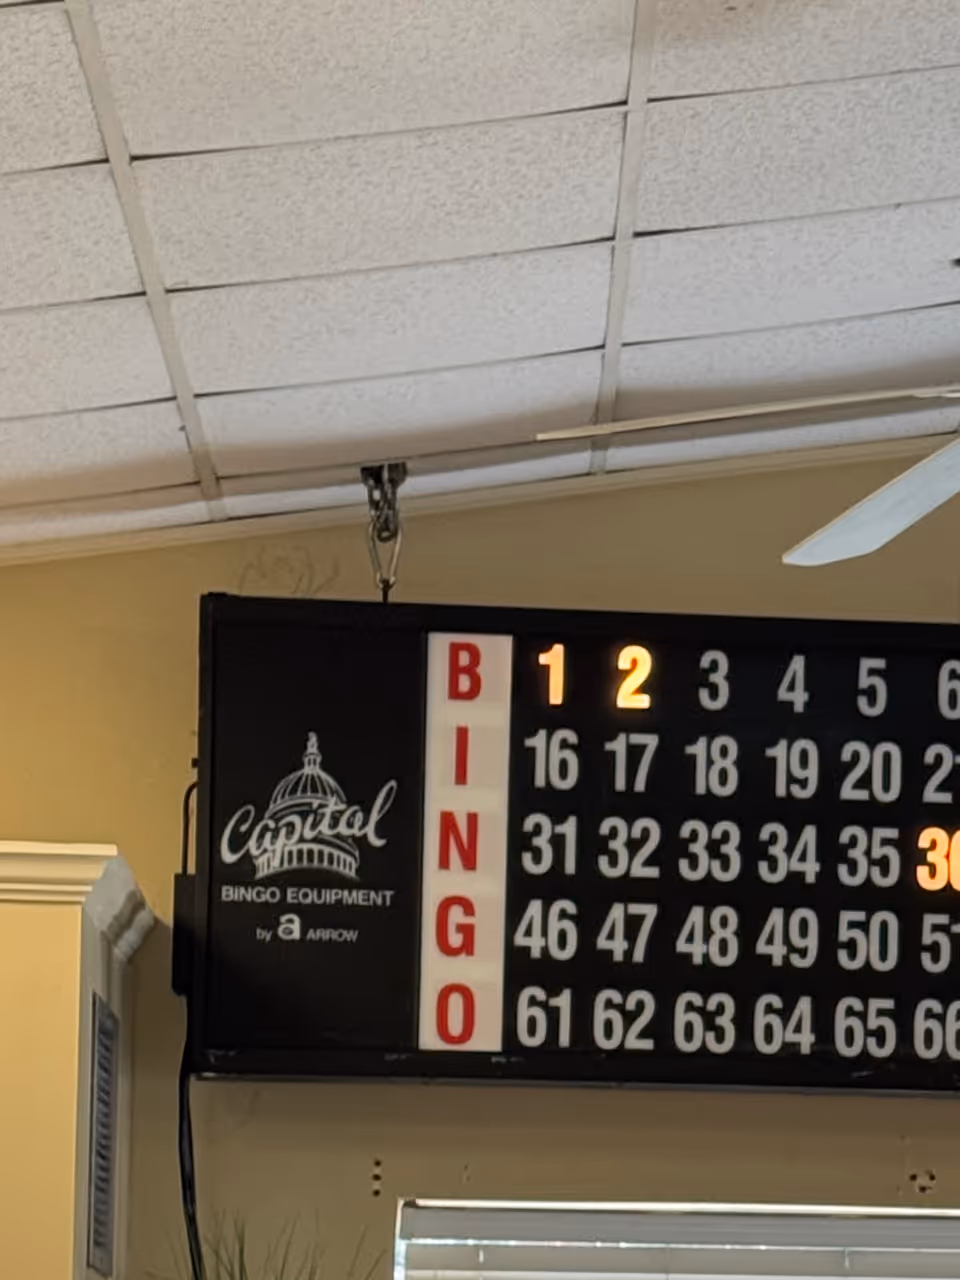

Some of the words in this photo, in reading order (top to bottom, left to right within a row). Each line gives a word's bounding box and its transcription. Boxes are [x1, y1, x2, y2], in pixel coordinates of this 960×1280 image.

[538, 643, 564, 705] 1
[616, 645, 652, 709] 2
[700, 651, 728, 709] 3
[779, 656, 808, 712] 4
[858, 659, 886, 715] 5
[525, 730, 578, 789] 16
[605, 734, 658, 791] 17
[686, 736, 737, 796] 18
[766, 740, 818, 798] 19
[841, 742, 901, 802] 20
[220, 779, 397, 869] Capital
[522, 814, 576, 874] 31
[599, 817, 660, 877] 32
[679, 821, 740, 881] 33
[759, 823, 819, 882] 34
[838, 826, 899, 886] 35
[221, 885, 280, 903] BINGO
[286, 888, 394, 906] EQUIPMENT
[256, 928, 272, 941] by
[306, 928, 359, 942] ARROW
[514, 900, 577, 960] 46
[597, 903, 657, 962] 47
[677, 906, 738, 966] 48
[757, 909, 818, 967] 49
[838, 911, 898, 971] 50
[517, 987, 570, 1046] 61
[594, 990, 654, 1049] 62
[675, 993, 735, 1053] 63
[755, 995, 814, 1053] 64
[835, 998, 895, 1057] 65
